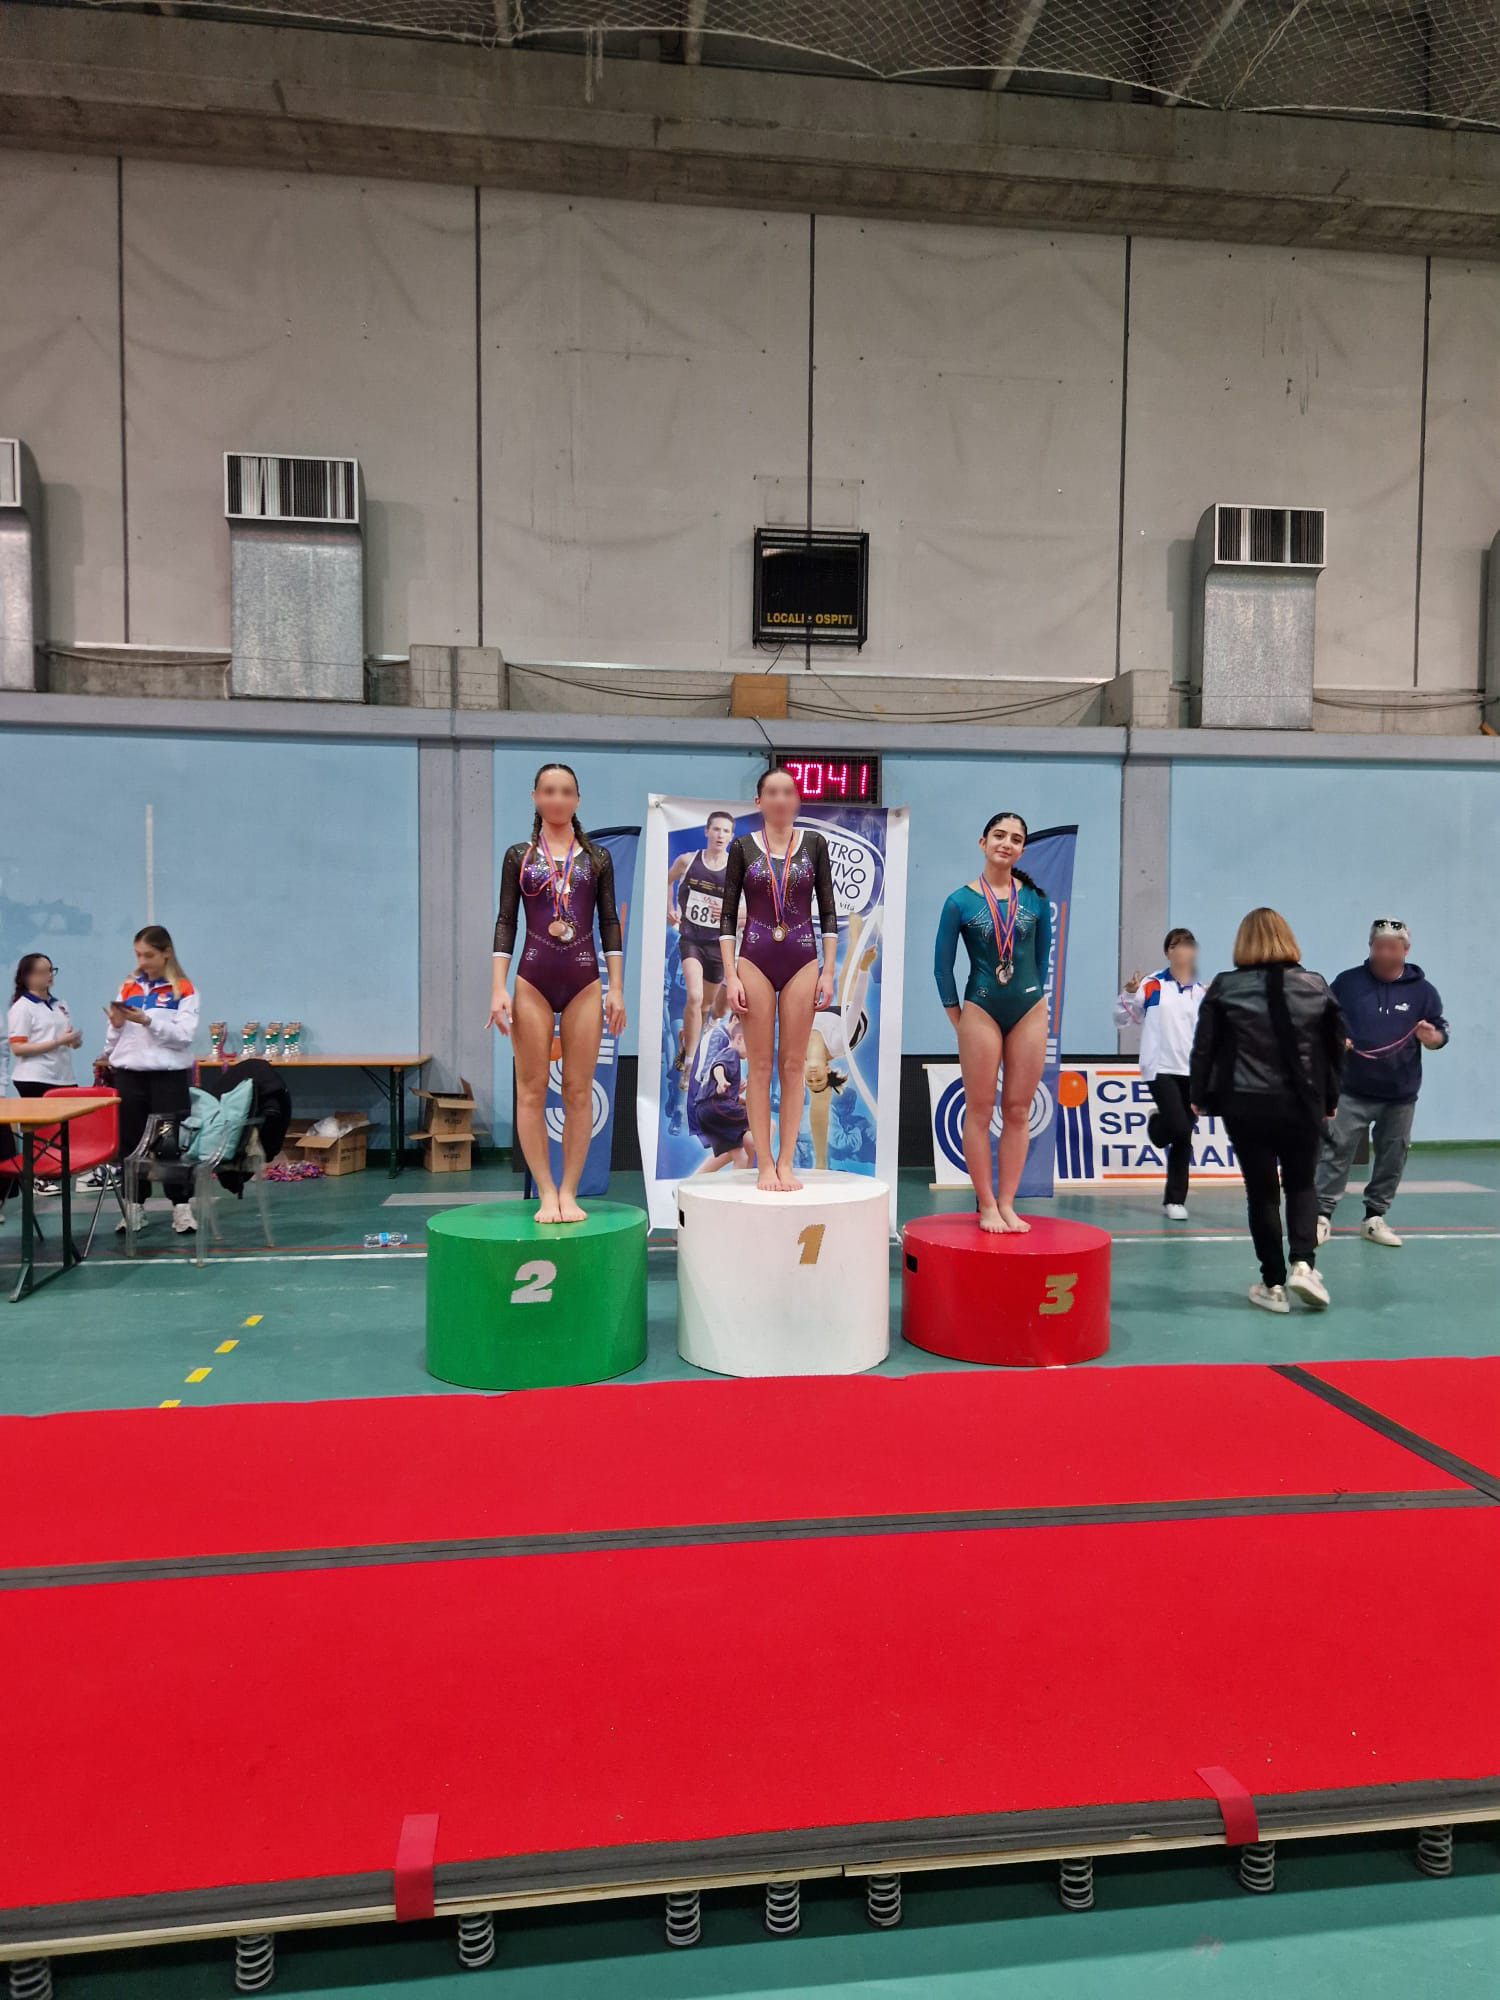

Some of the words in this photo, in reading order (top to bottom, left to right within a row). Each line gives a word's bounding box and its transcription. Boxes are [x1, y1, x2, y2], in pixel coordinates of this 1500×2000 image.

[767, 613, 804, 624] LOCALI
[815, 613, 853, 625] OSPITI
[826, 840, 864, 864] TRO
[830, 860, 866, 884] TIVO
[797, 1223, 827, 1265] 1
[510, 1260, 557, 1304] 2
[1039, 1272, 1078, 1315] 3
